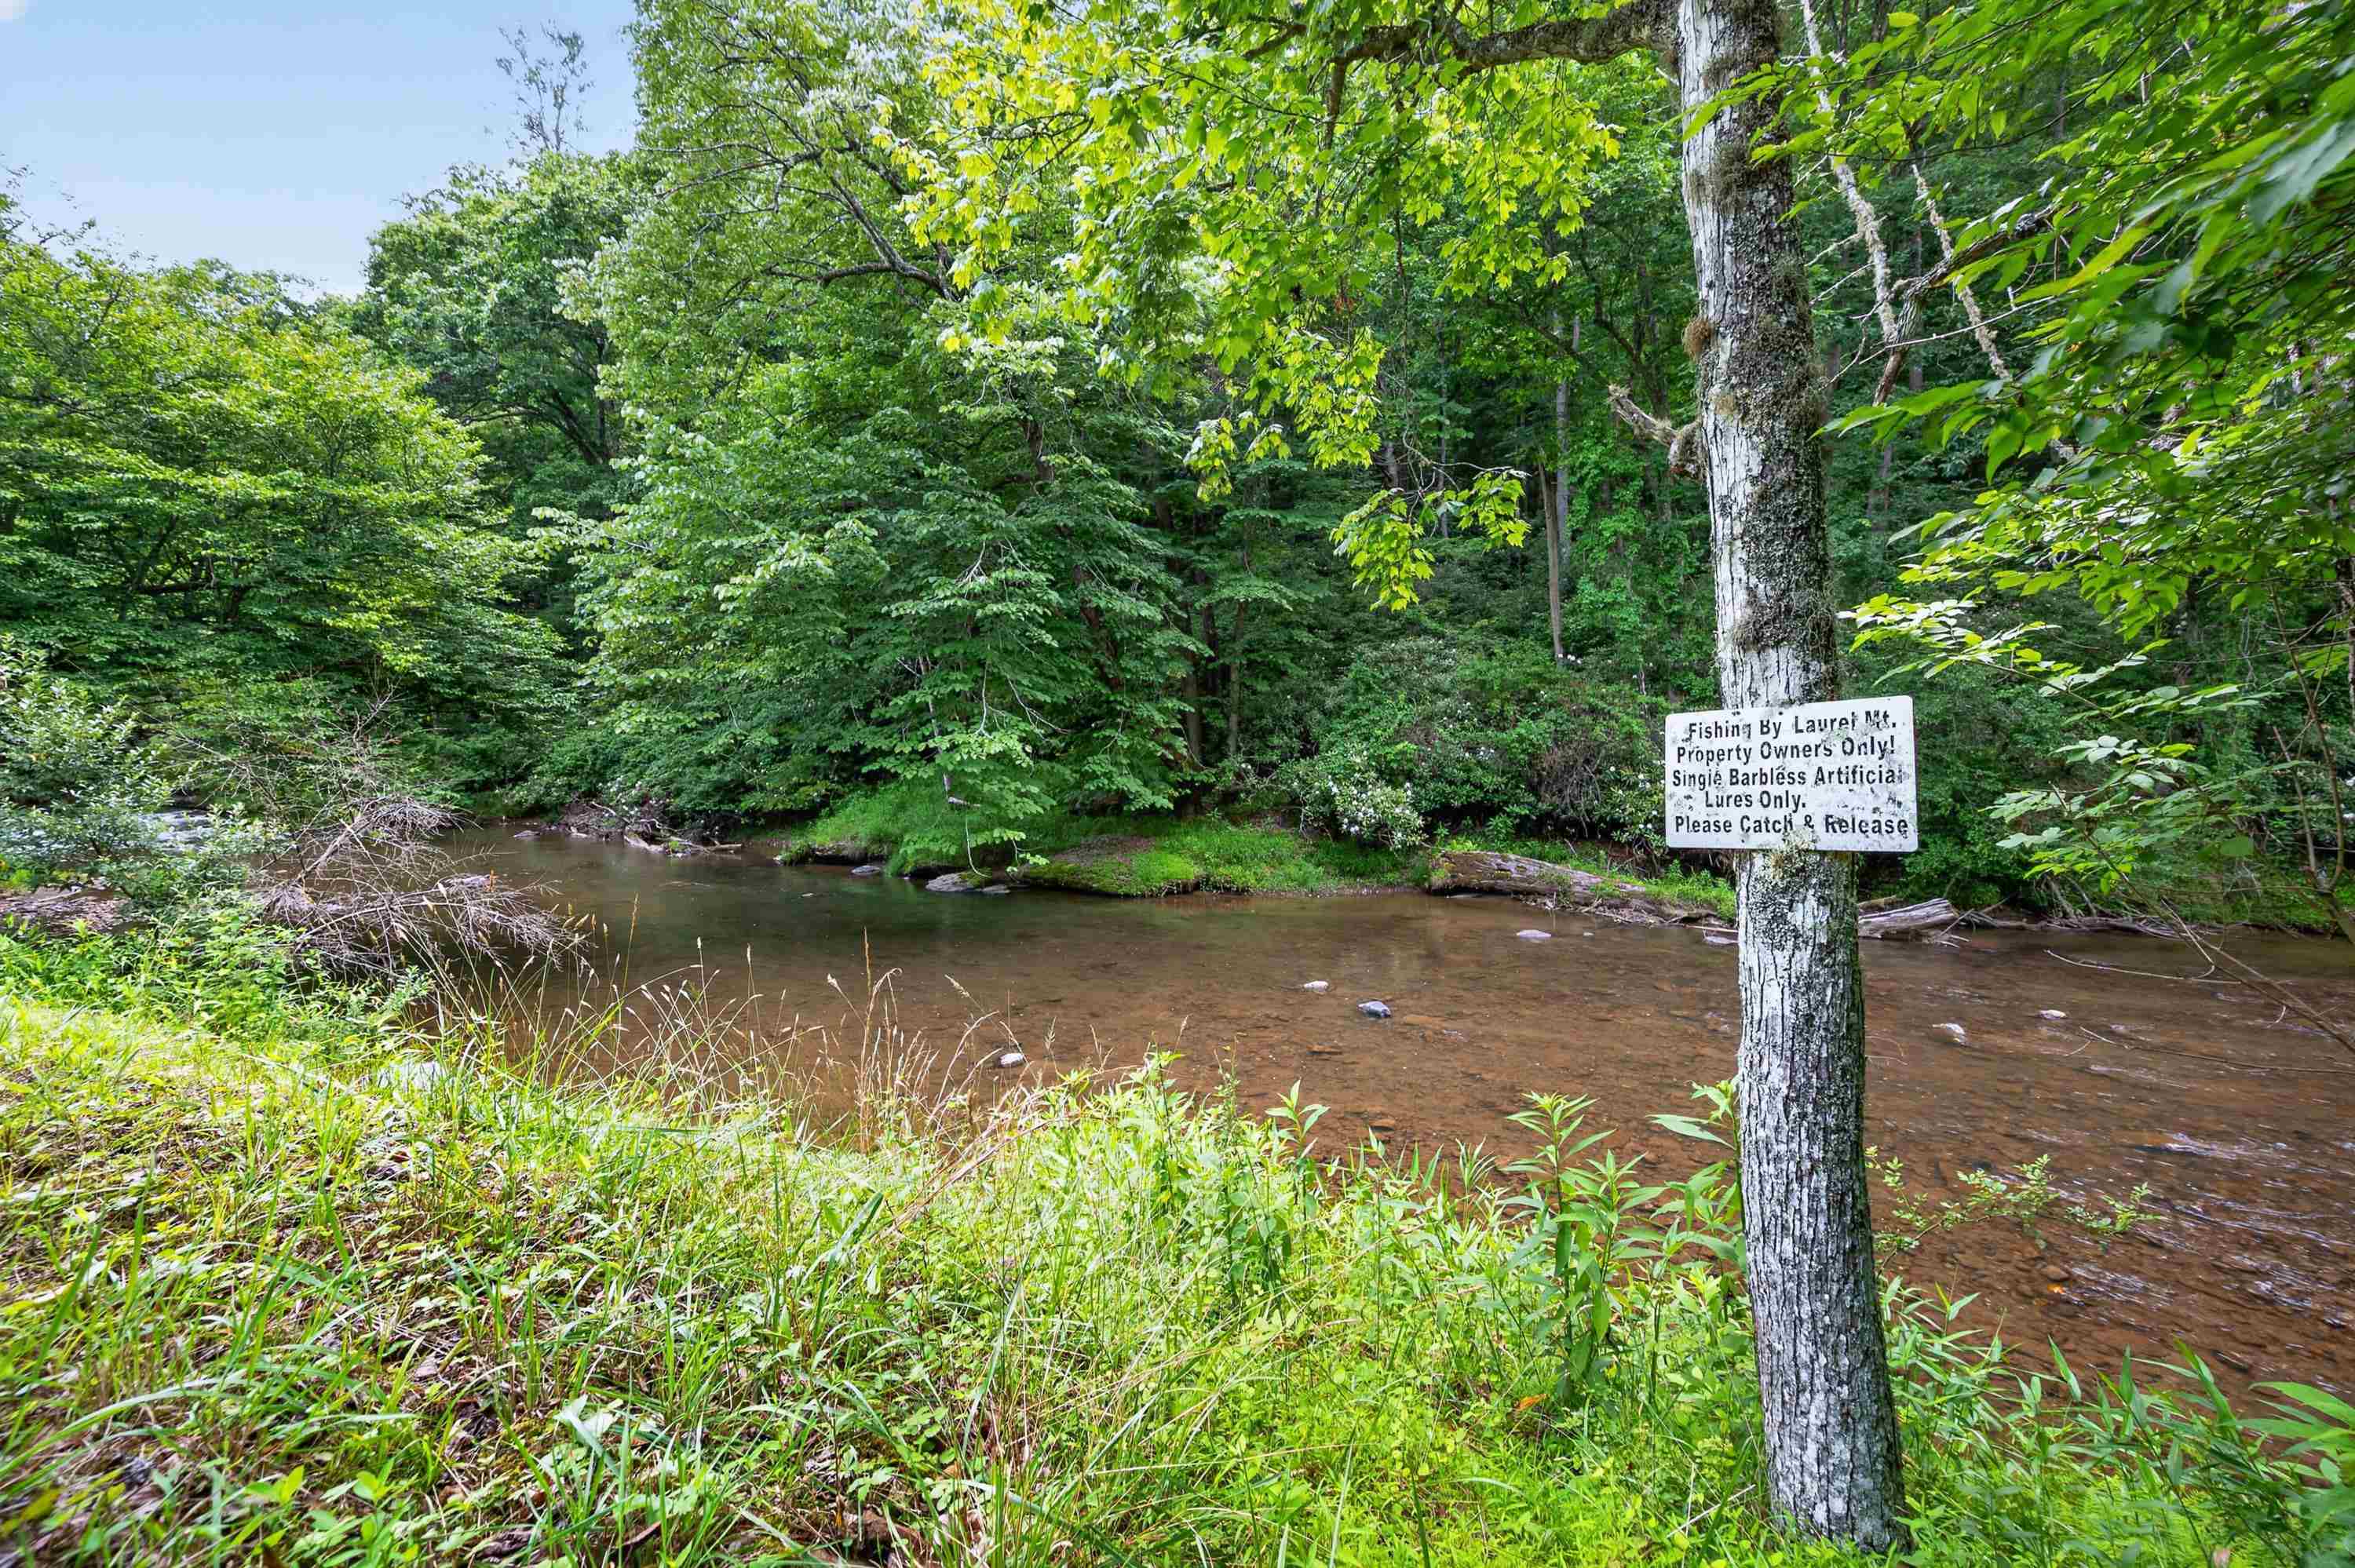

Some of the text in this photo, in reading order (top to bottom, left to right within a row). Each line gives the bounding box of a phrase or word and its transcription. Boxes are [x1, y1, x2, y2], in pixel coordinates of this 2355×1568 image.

[1760, 719, 1782, 738] By
[1795, 711, 1856, 735] Laurel
[1677, 735, 1895, 767] Property Owners Only!
[1673, 764, 1904, 791] Single Barbless Artificial
[1705, 790, 1806, 813] Lures Only.
[1675, 814, 1908, 835] Please Catch & Release
